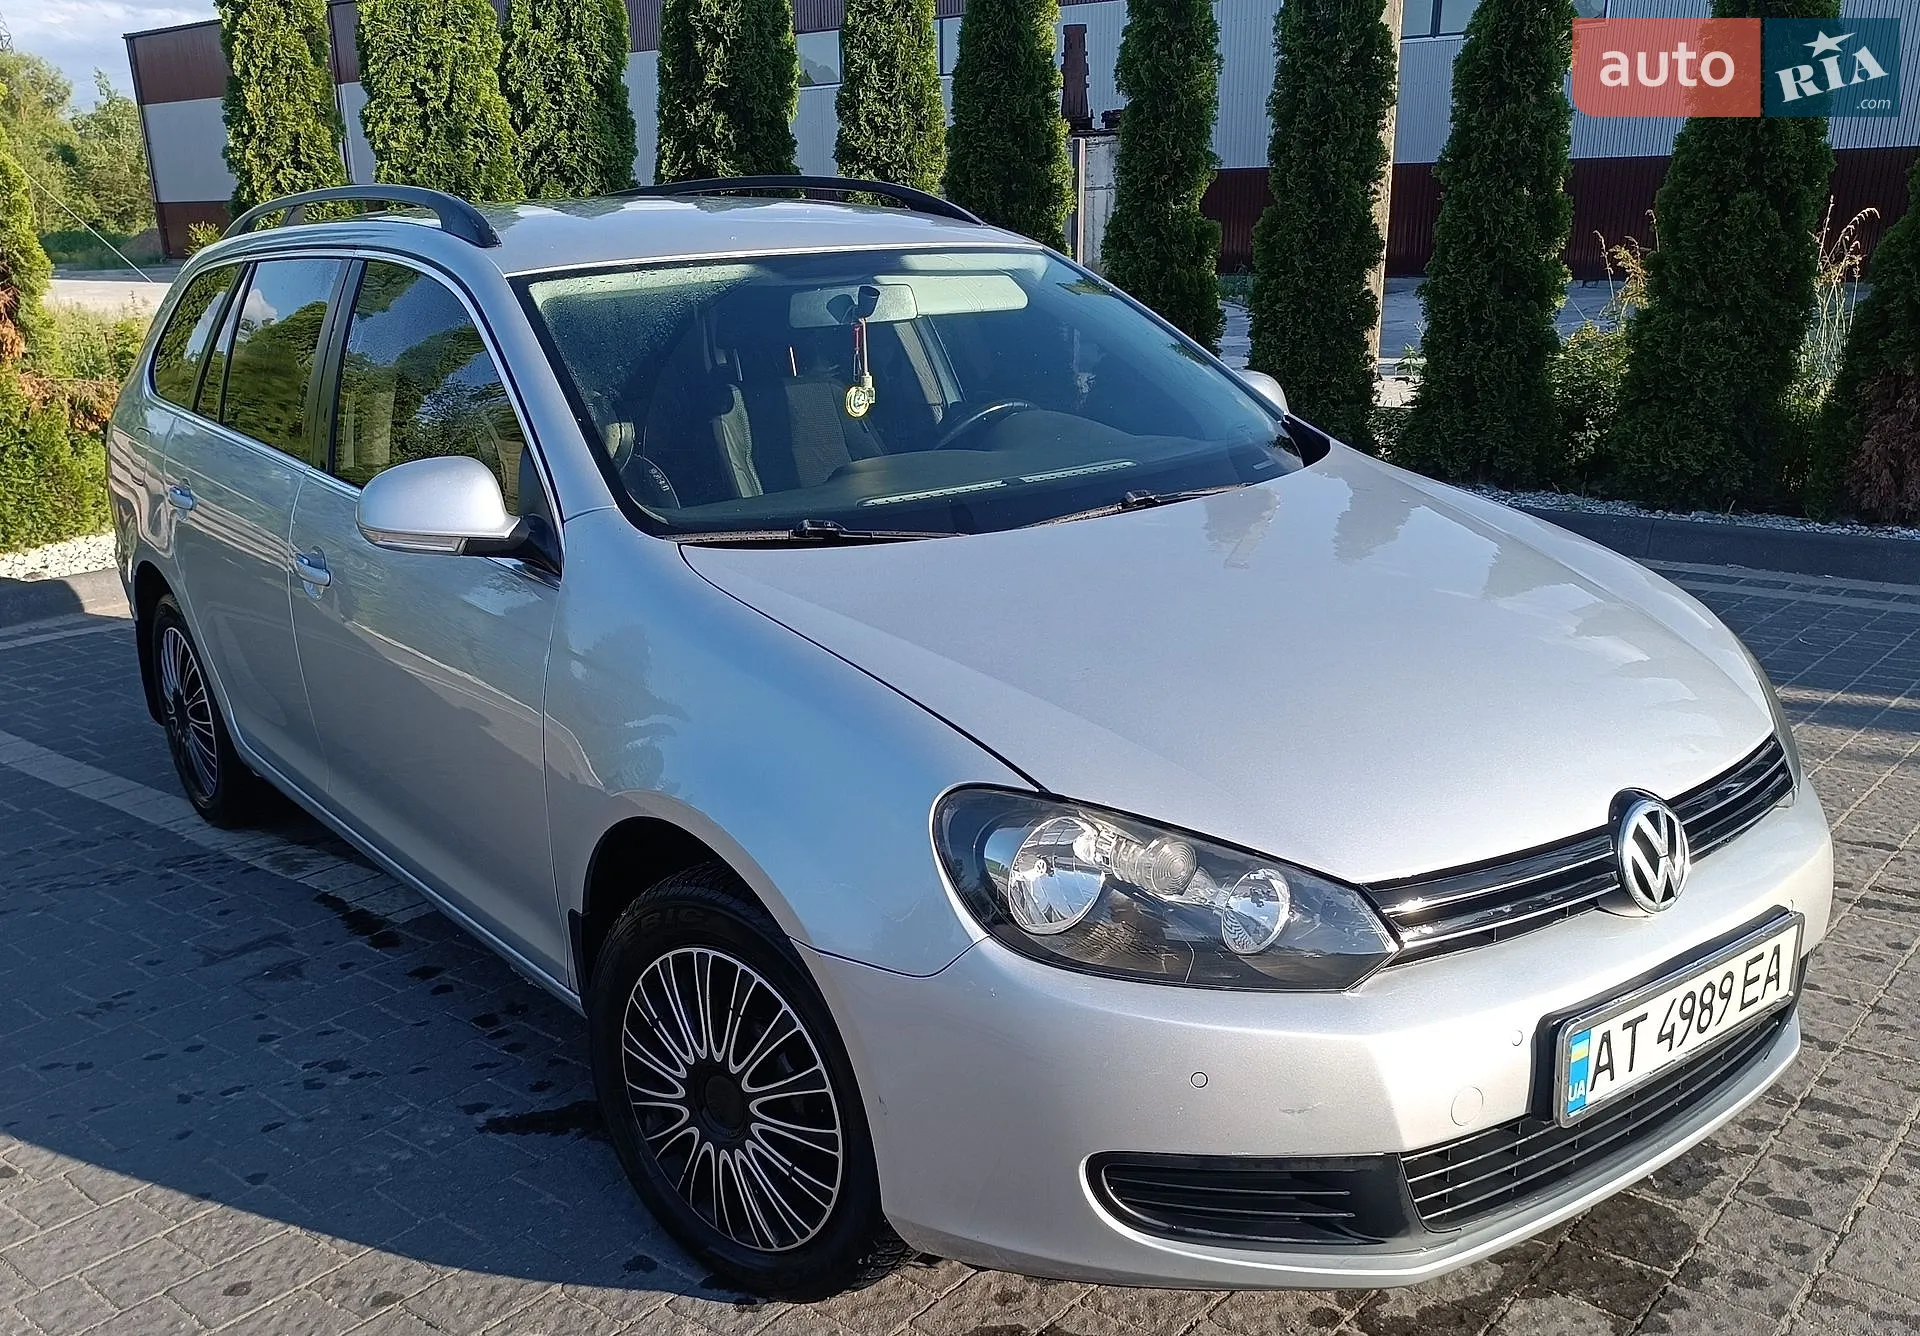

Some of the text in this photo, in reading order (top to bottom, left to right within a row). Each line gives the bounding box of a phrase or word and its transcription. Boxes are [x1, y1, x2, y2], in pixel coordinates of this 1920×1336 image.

[1622, 802, 1686, 909] VW
[1590, 943, 1781, 1092] AT 4989 EA
[1568, 1079, 1586, 1102] UA
